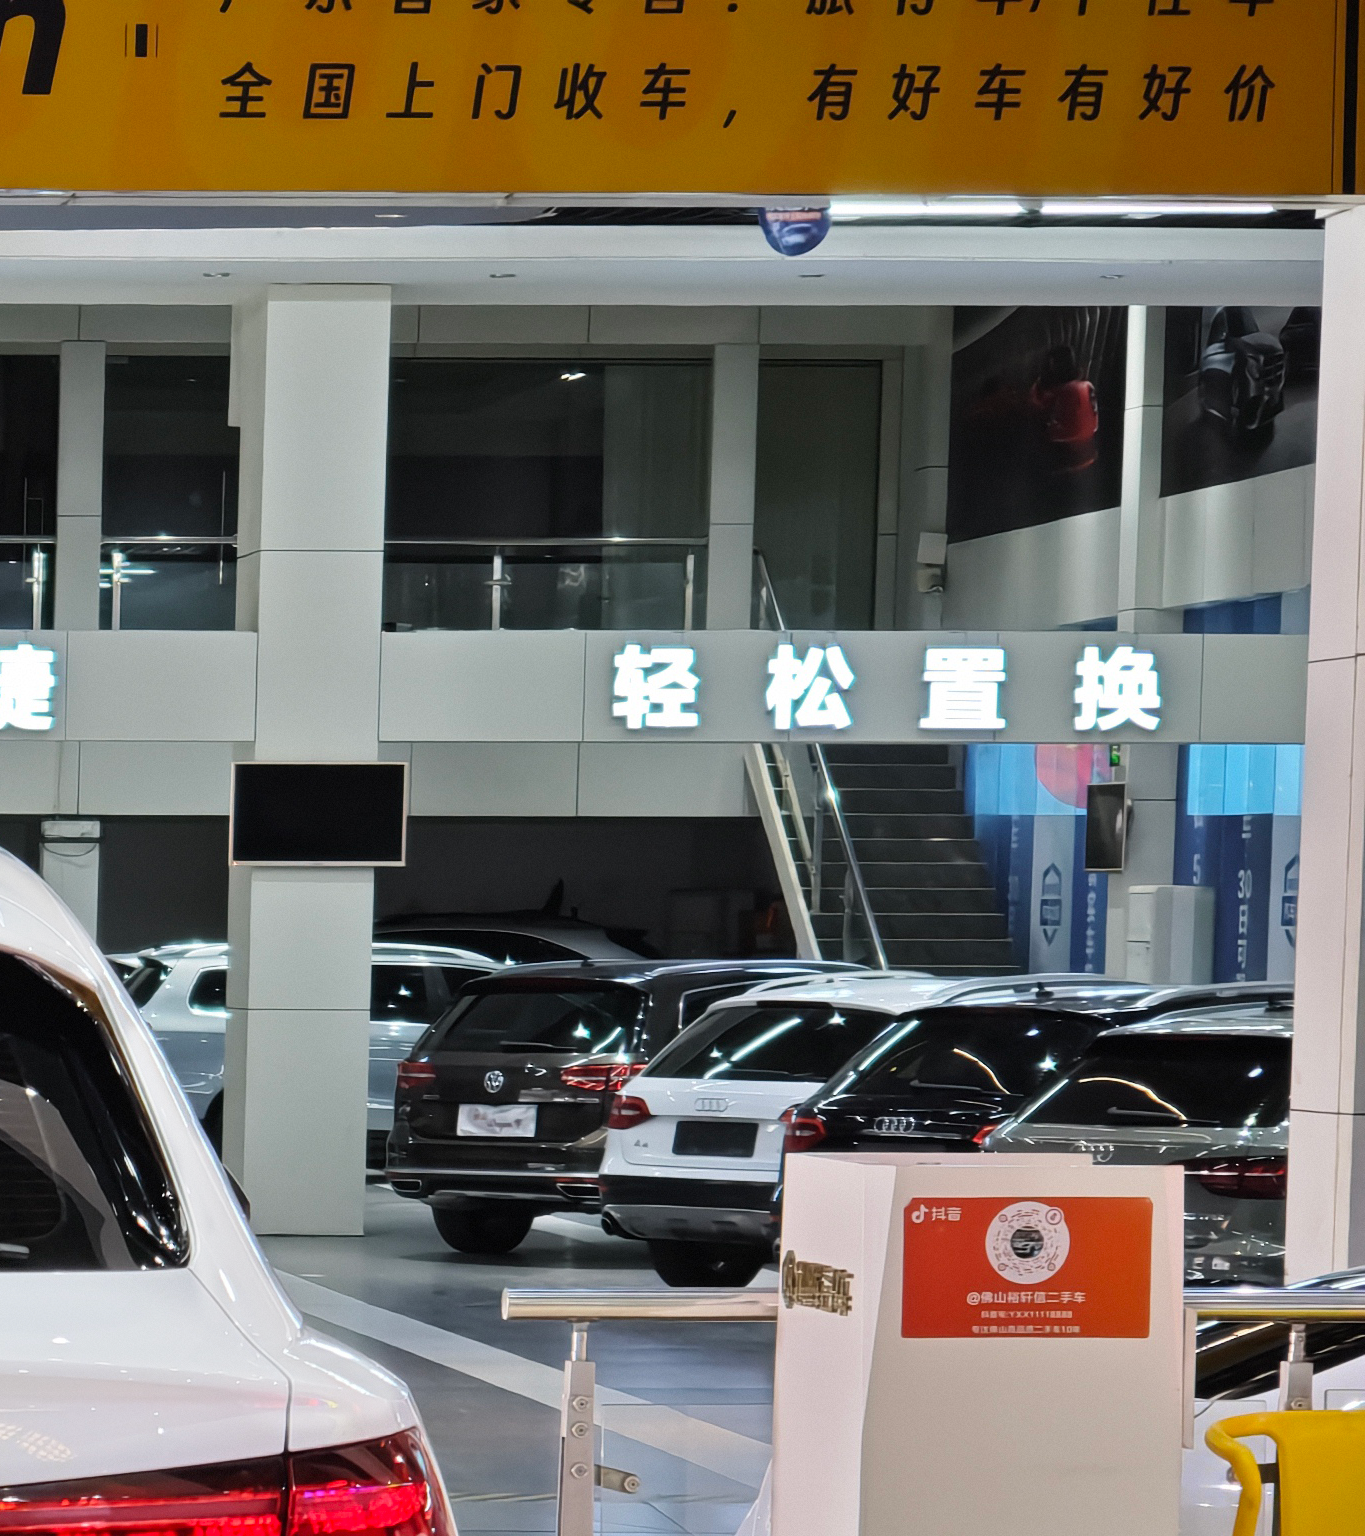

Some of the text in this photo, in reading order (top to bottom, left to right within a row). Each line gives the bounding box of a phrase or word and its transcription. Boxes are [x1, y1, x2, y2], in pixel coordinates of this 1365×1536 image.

[611, 642, 1163, 732] 轻松置换
[931, 1206, 962, 1221] 抖音
